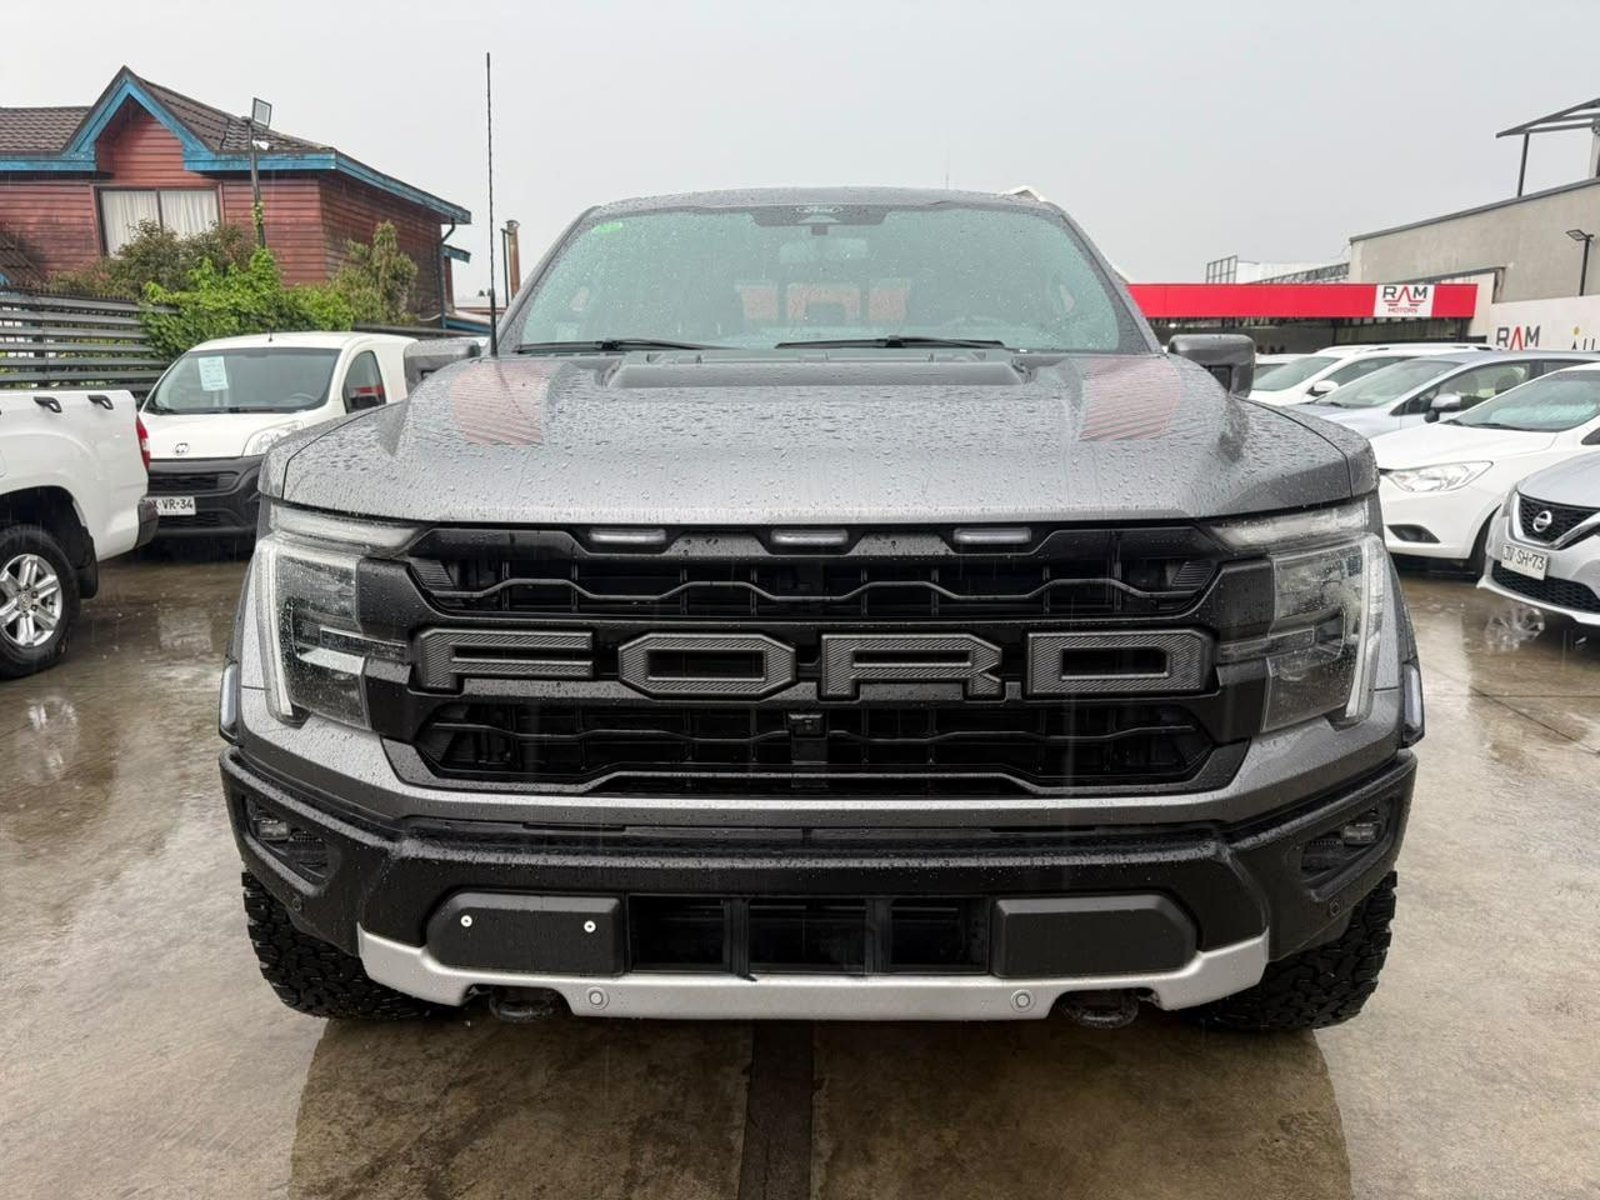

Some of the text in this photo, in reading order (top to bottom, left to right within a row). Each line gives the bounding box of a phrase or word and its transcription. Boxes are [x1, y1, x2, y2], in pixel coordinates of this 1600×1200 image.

[1382, 285, 1428, 301] RAM
[1495, 325, 1540, 350] RAM
[415, 628, 1214, 699] FORD
